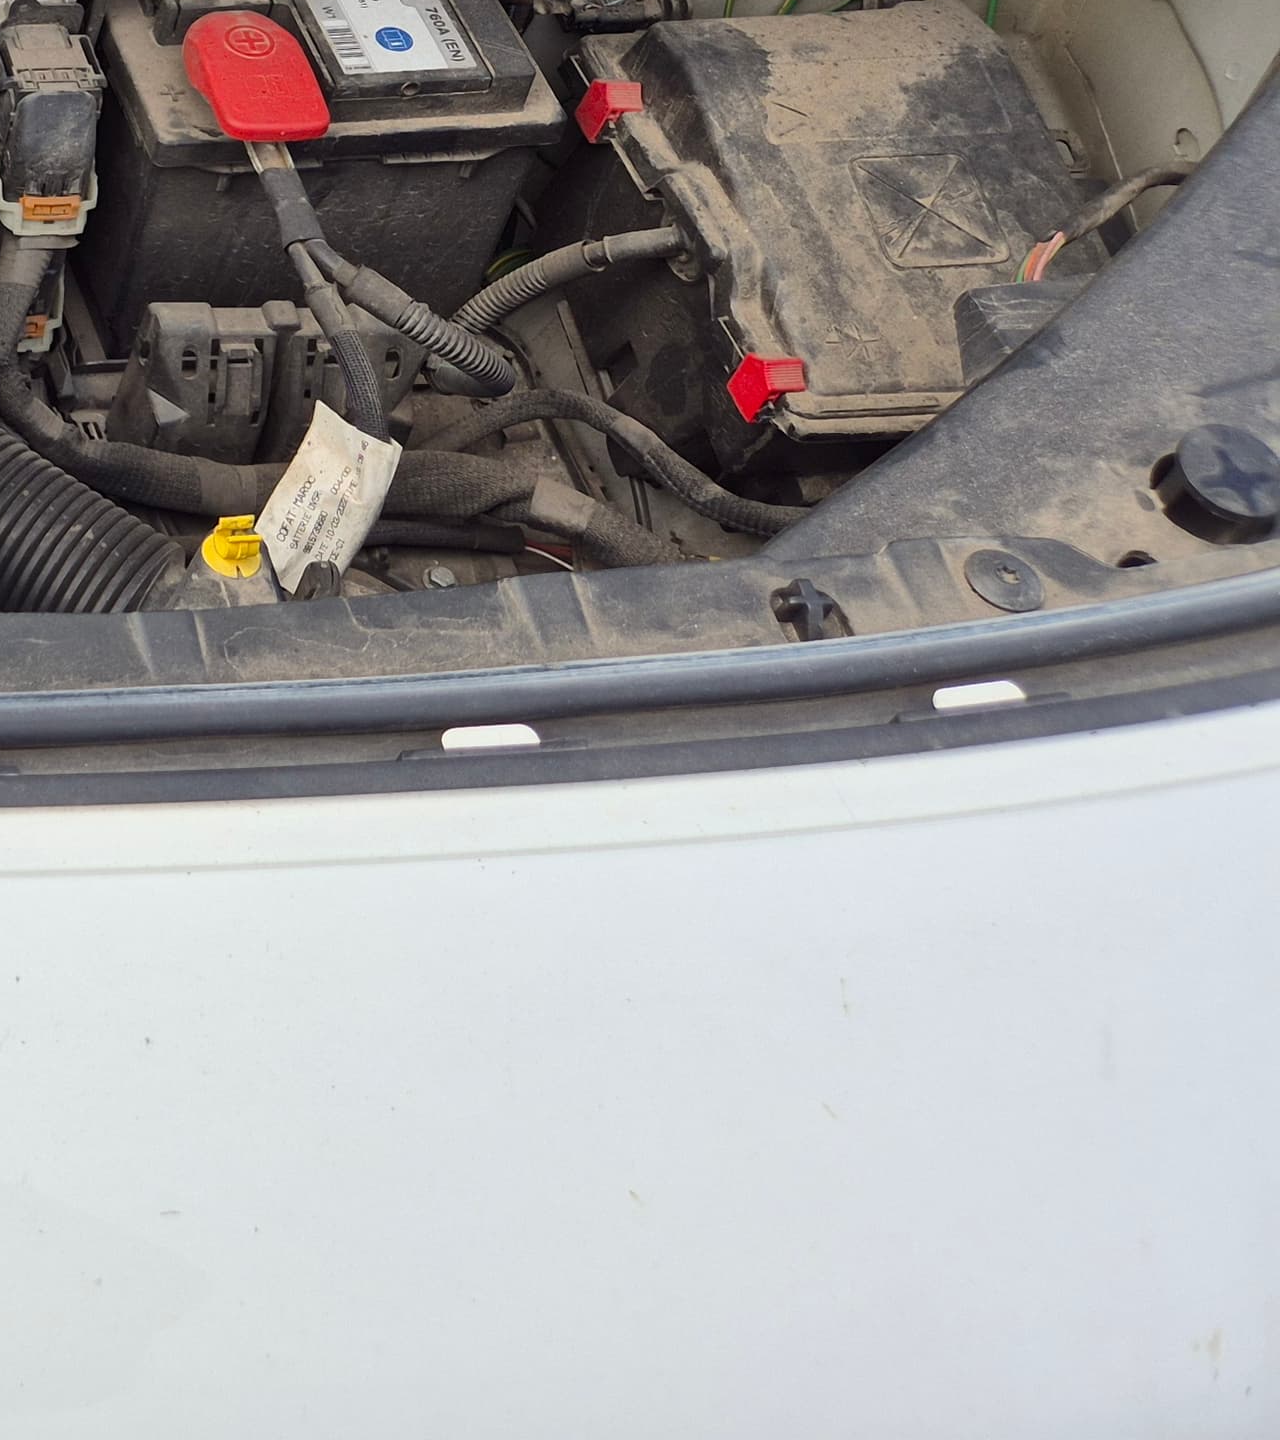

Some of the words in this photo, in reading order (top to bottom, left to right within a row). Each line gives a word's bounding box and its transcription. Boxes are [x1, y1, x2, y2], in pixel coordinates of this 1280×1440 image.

[425, 7, 450, 36] 760A
[442, 37, 466, 62] (EN)
[276, 510, 297, 542] COFAT
[292, 475, 316, 507] MAROC
[289, 511, 313, 550] BATTERIE
[315, 542, 329, 561] DATE
